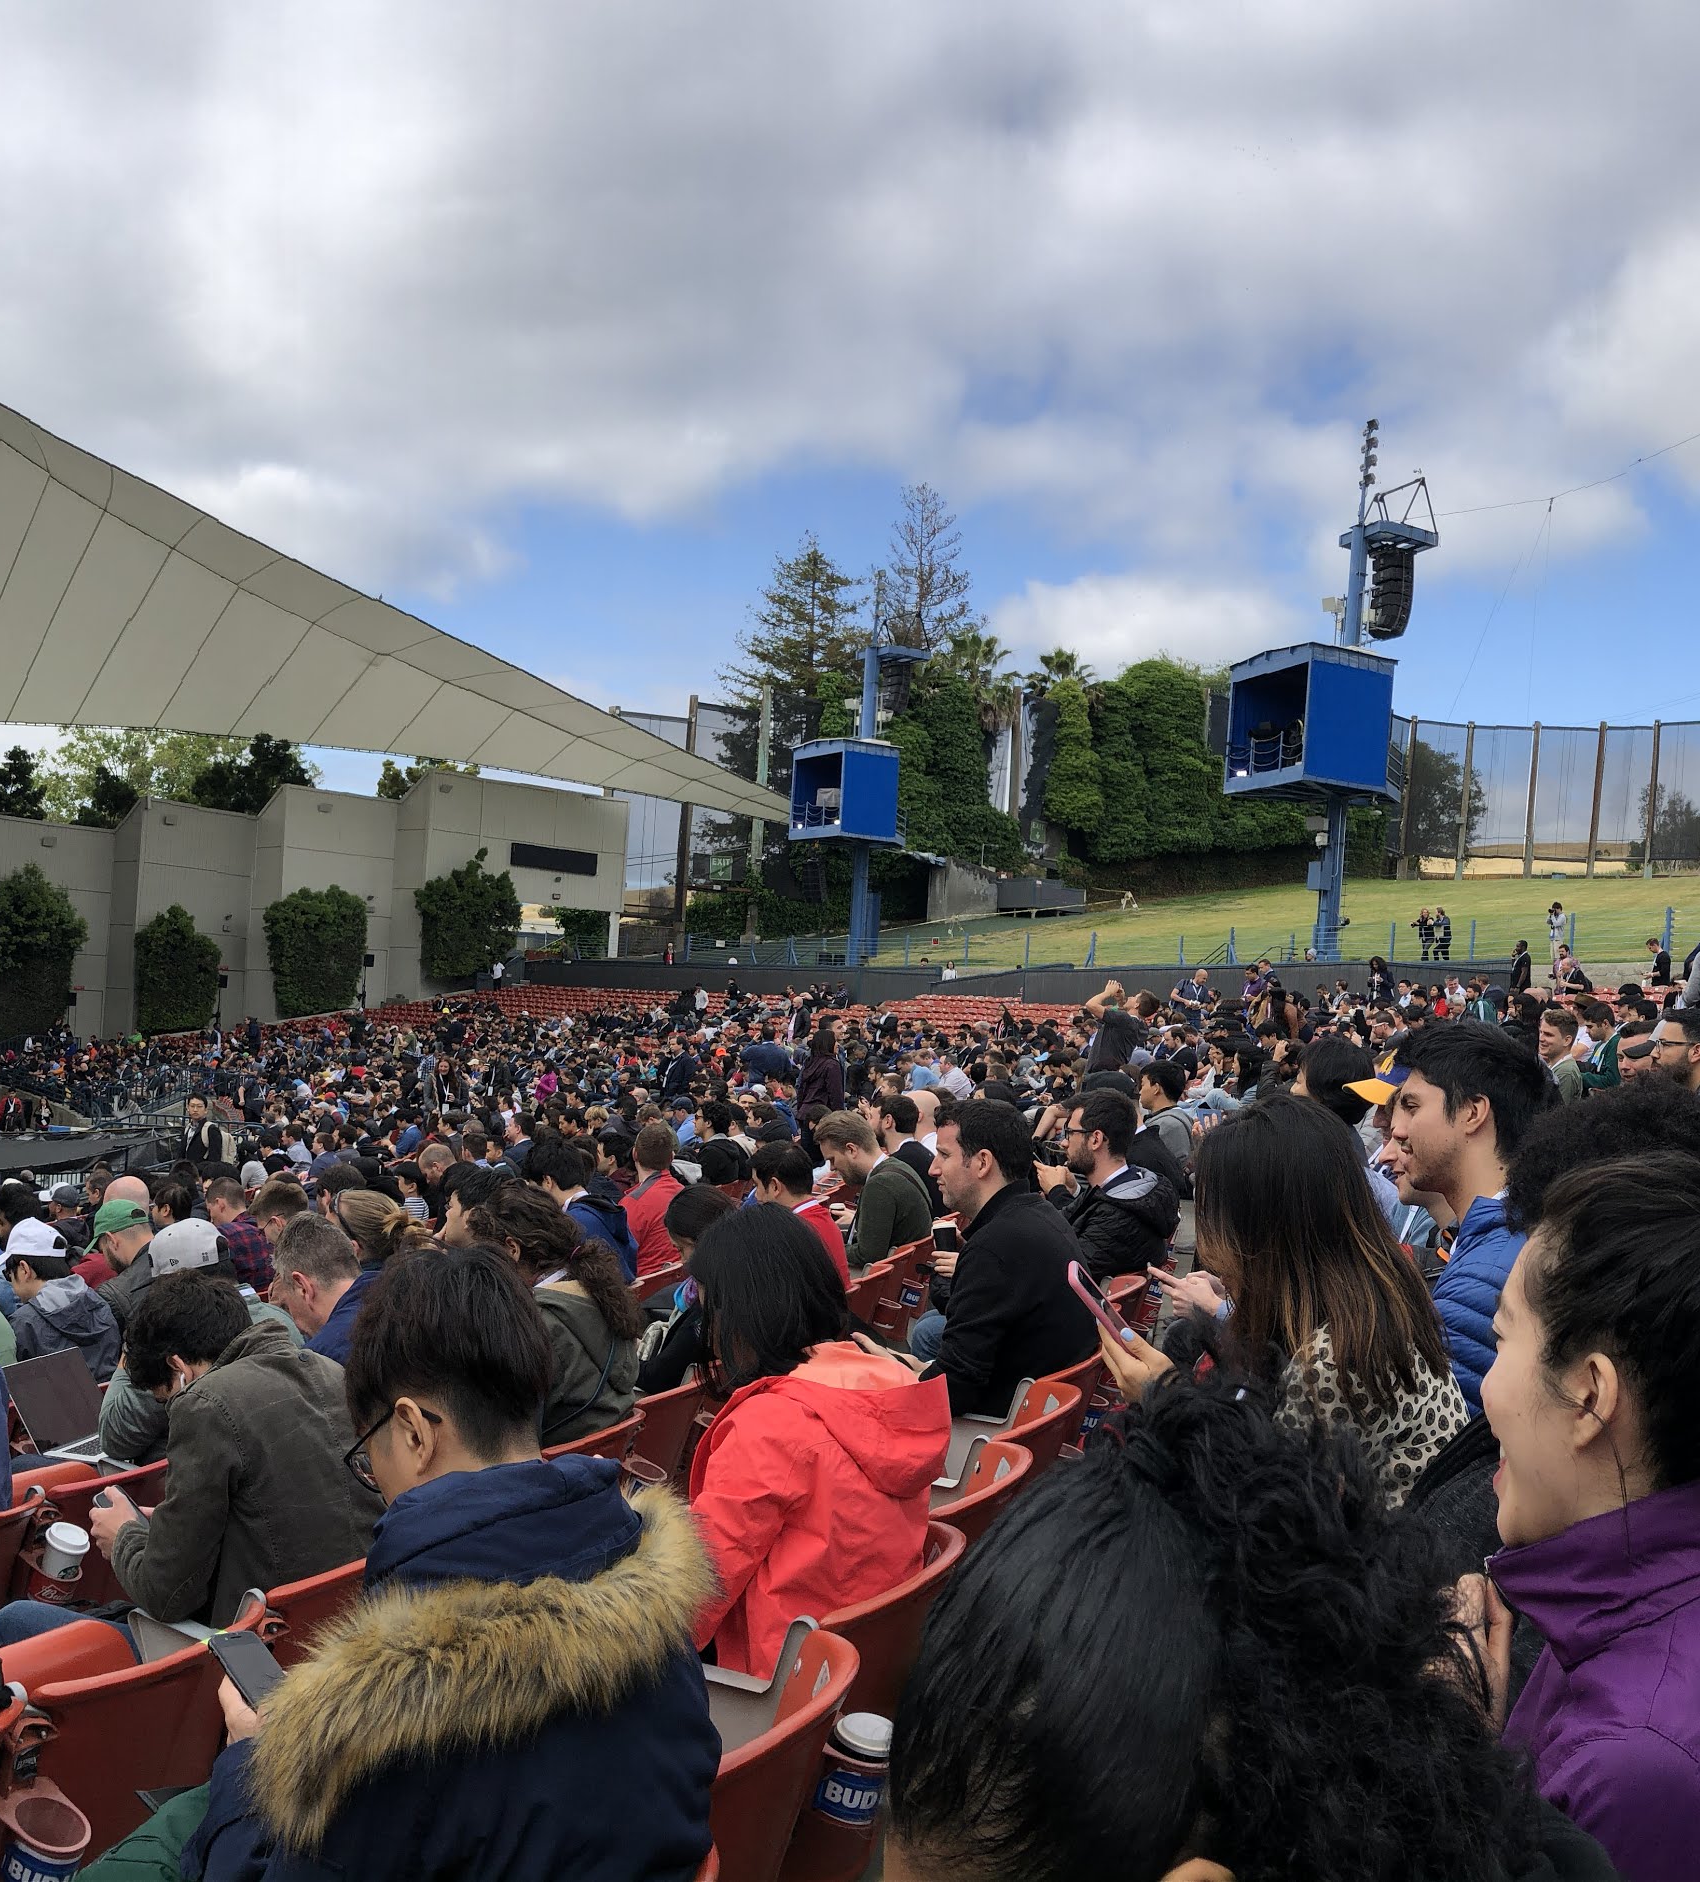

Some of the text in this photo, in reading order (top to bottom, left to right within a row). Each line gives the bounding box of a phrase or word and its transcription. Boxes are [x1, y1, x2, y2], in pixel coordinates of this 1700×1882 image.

[1032, 821, 1044, 831] EXIT
[712, 857, 731, 866] EXIT
[825, 1779, 878, 1810] BUD
